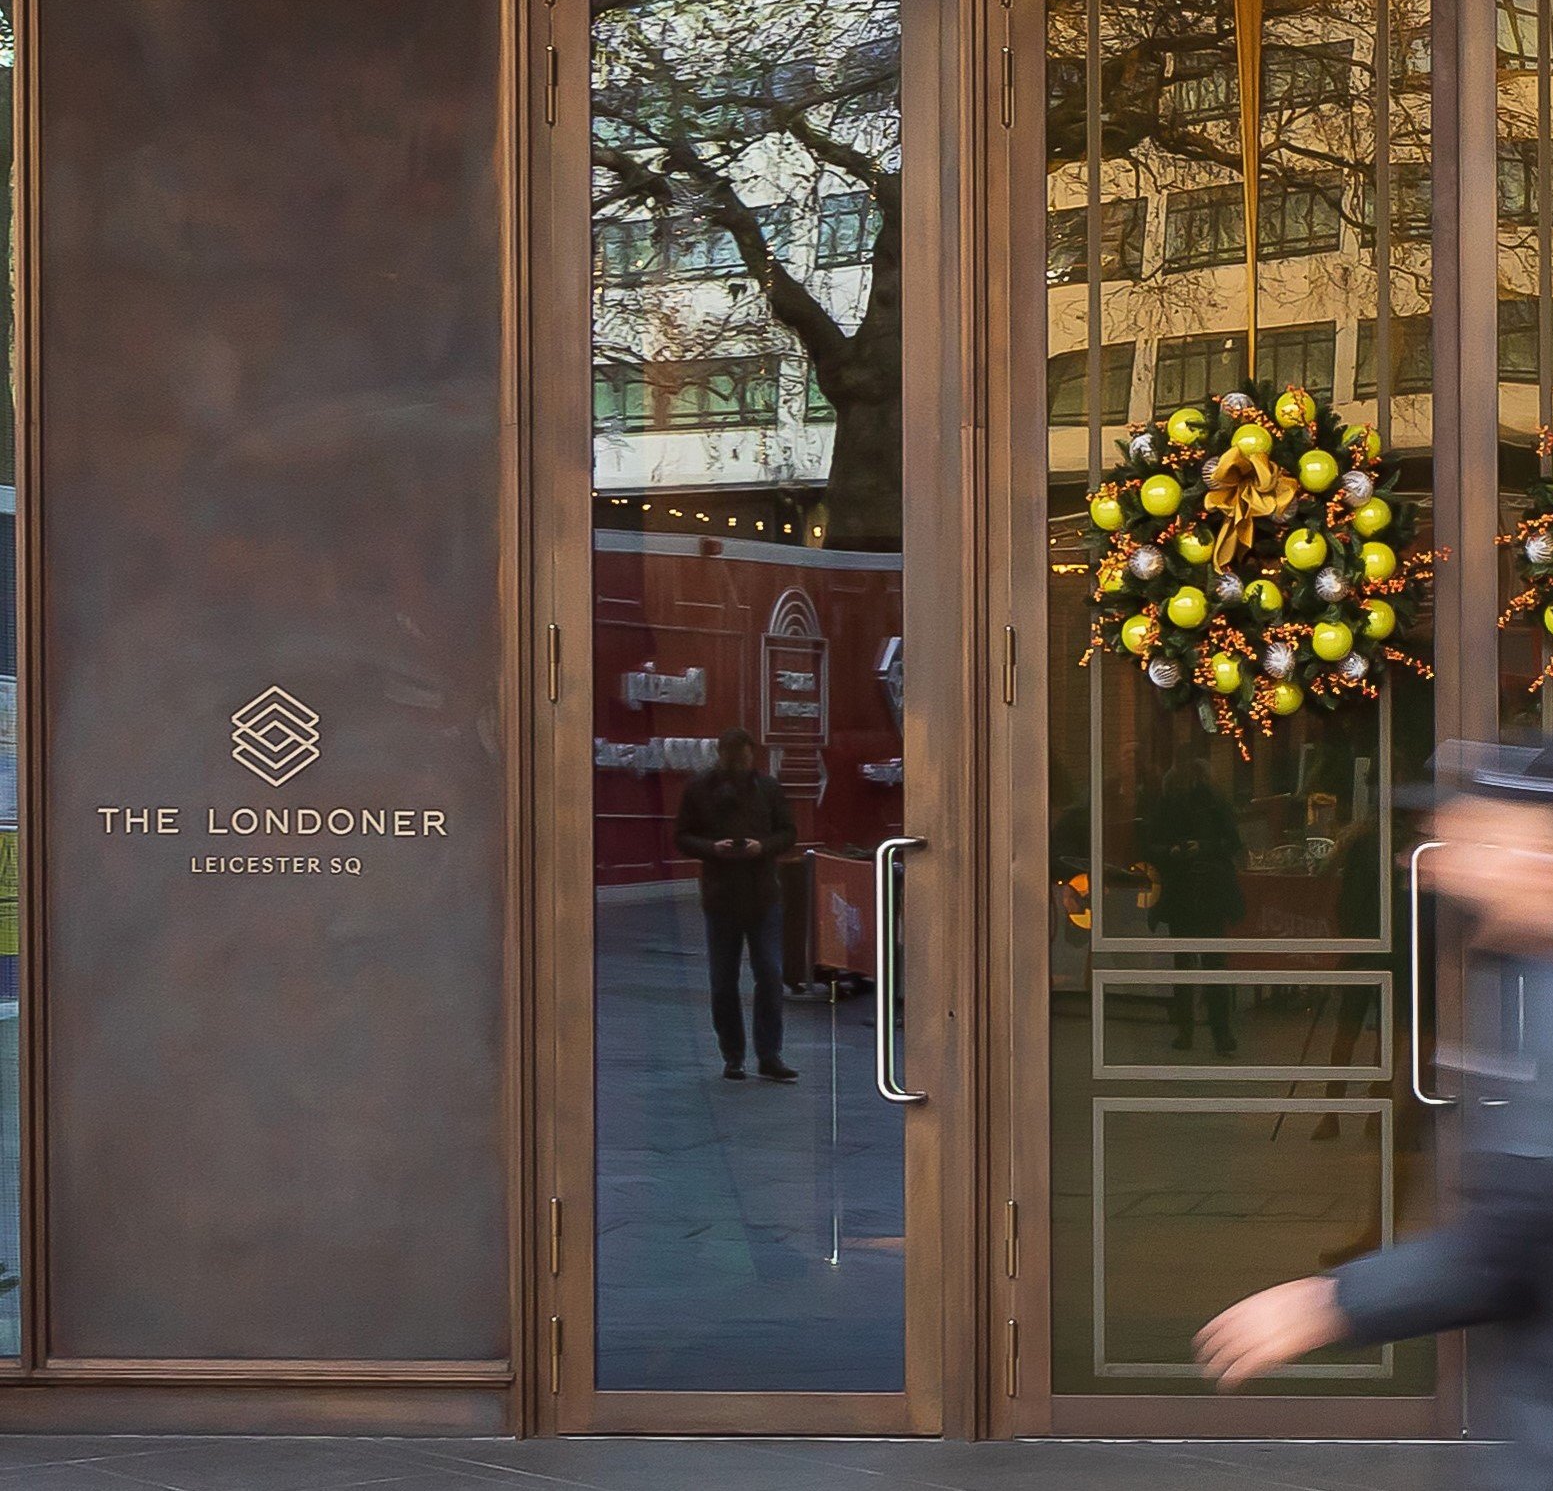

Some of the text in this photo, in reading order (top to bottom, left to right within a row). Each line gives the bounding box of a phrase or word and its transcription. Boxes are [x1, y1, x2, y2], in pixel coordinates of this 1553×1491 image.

[96, 807, 449, 837] THE LONDONER
[190, 856, 363, 877] LEICESTER SQ
